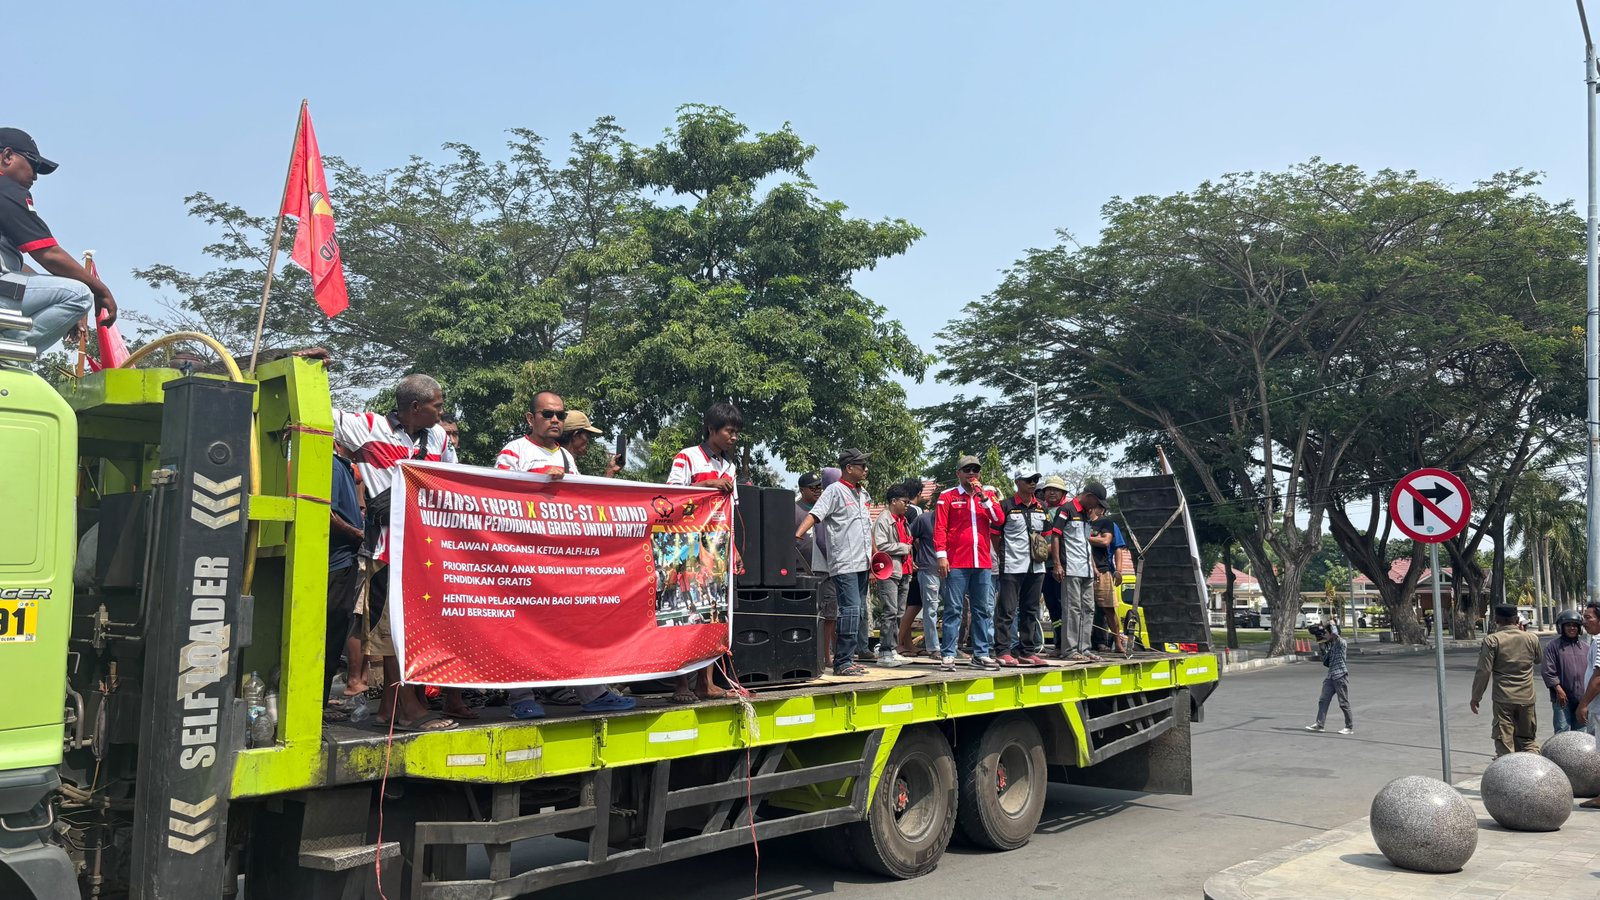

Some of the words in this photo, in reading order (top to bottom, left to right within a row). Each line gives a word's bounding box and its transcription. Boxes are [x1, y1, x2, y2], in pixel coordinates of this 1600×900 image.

[417, 487, 480, 512] ALIANSI
[481, 497, 524, 517] FNPBI
[526, 501, 537, 518] X
[539, 502, 594, 521] SBTC-ST
[596, 505, 607, 522] X
[608, 506, 648, 522] LMND
[419, 508, 482, 531] WUJUDKAN
[484, 515, 546, 534] PENDIDIKAN
[546, 521, 582, 536] GRATIS
[582, 522, 614, 537] UNTUK
[614, 523, 648, 538] RAKYAT
[441, 540, 489, 551] MELAWAN
[491, 543, 535, 554] AROGANSI
[537, 546, 564, 555] KETUA
[565, 547, 600, 556] ALFI-ILFA
[443, 560, 509, 573] PRIORITASKAN
[511, 565, 537, 574] ANAK
[538, 565, 565, 574] BURUH
[566, 566, 583, 575] IKUT
[585, 566, 625, 575] PROGRAM
[443, 573, 495, 586] PENDIDIKAN
[497, 577, 532, 586] GRATIS
[0, 588, 52, 600] GER
[443, 593, 487, 604] HENTIKAN
[488, 596, 551, 606] PELARANGAN
[552, 596, 573, 605] BAGI
[574, 596, 597, 605] SUPIR
[598, 595, 621, 604] YANG
[186, 556, 229, 684] LOADER
[441, 607, 466, 616] MAU
[467, 607, 516, 618] BERSERIKAT
[180, 692, 219, 770] SELF
